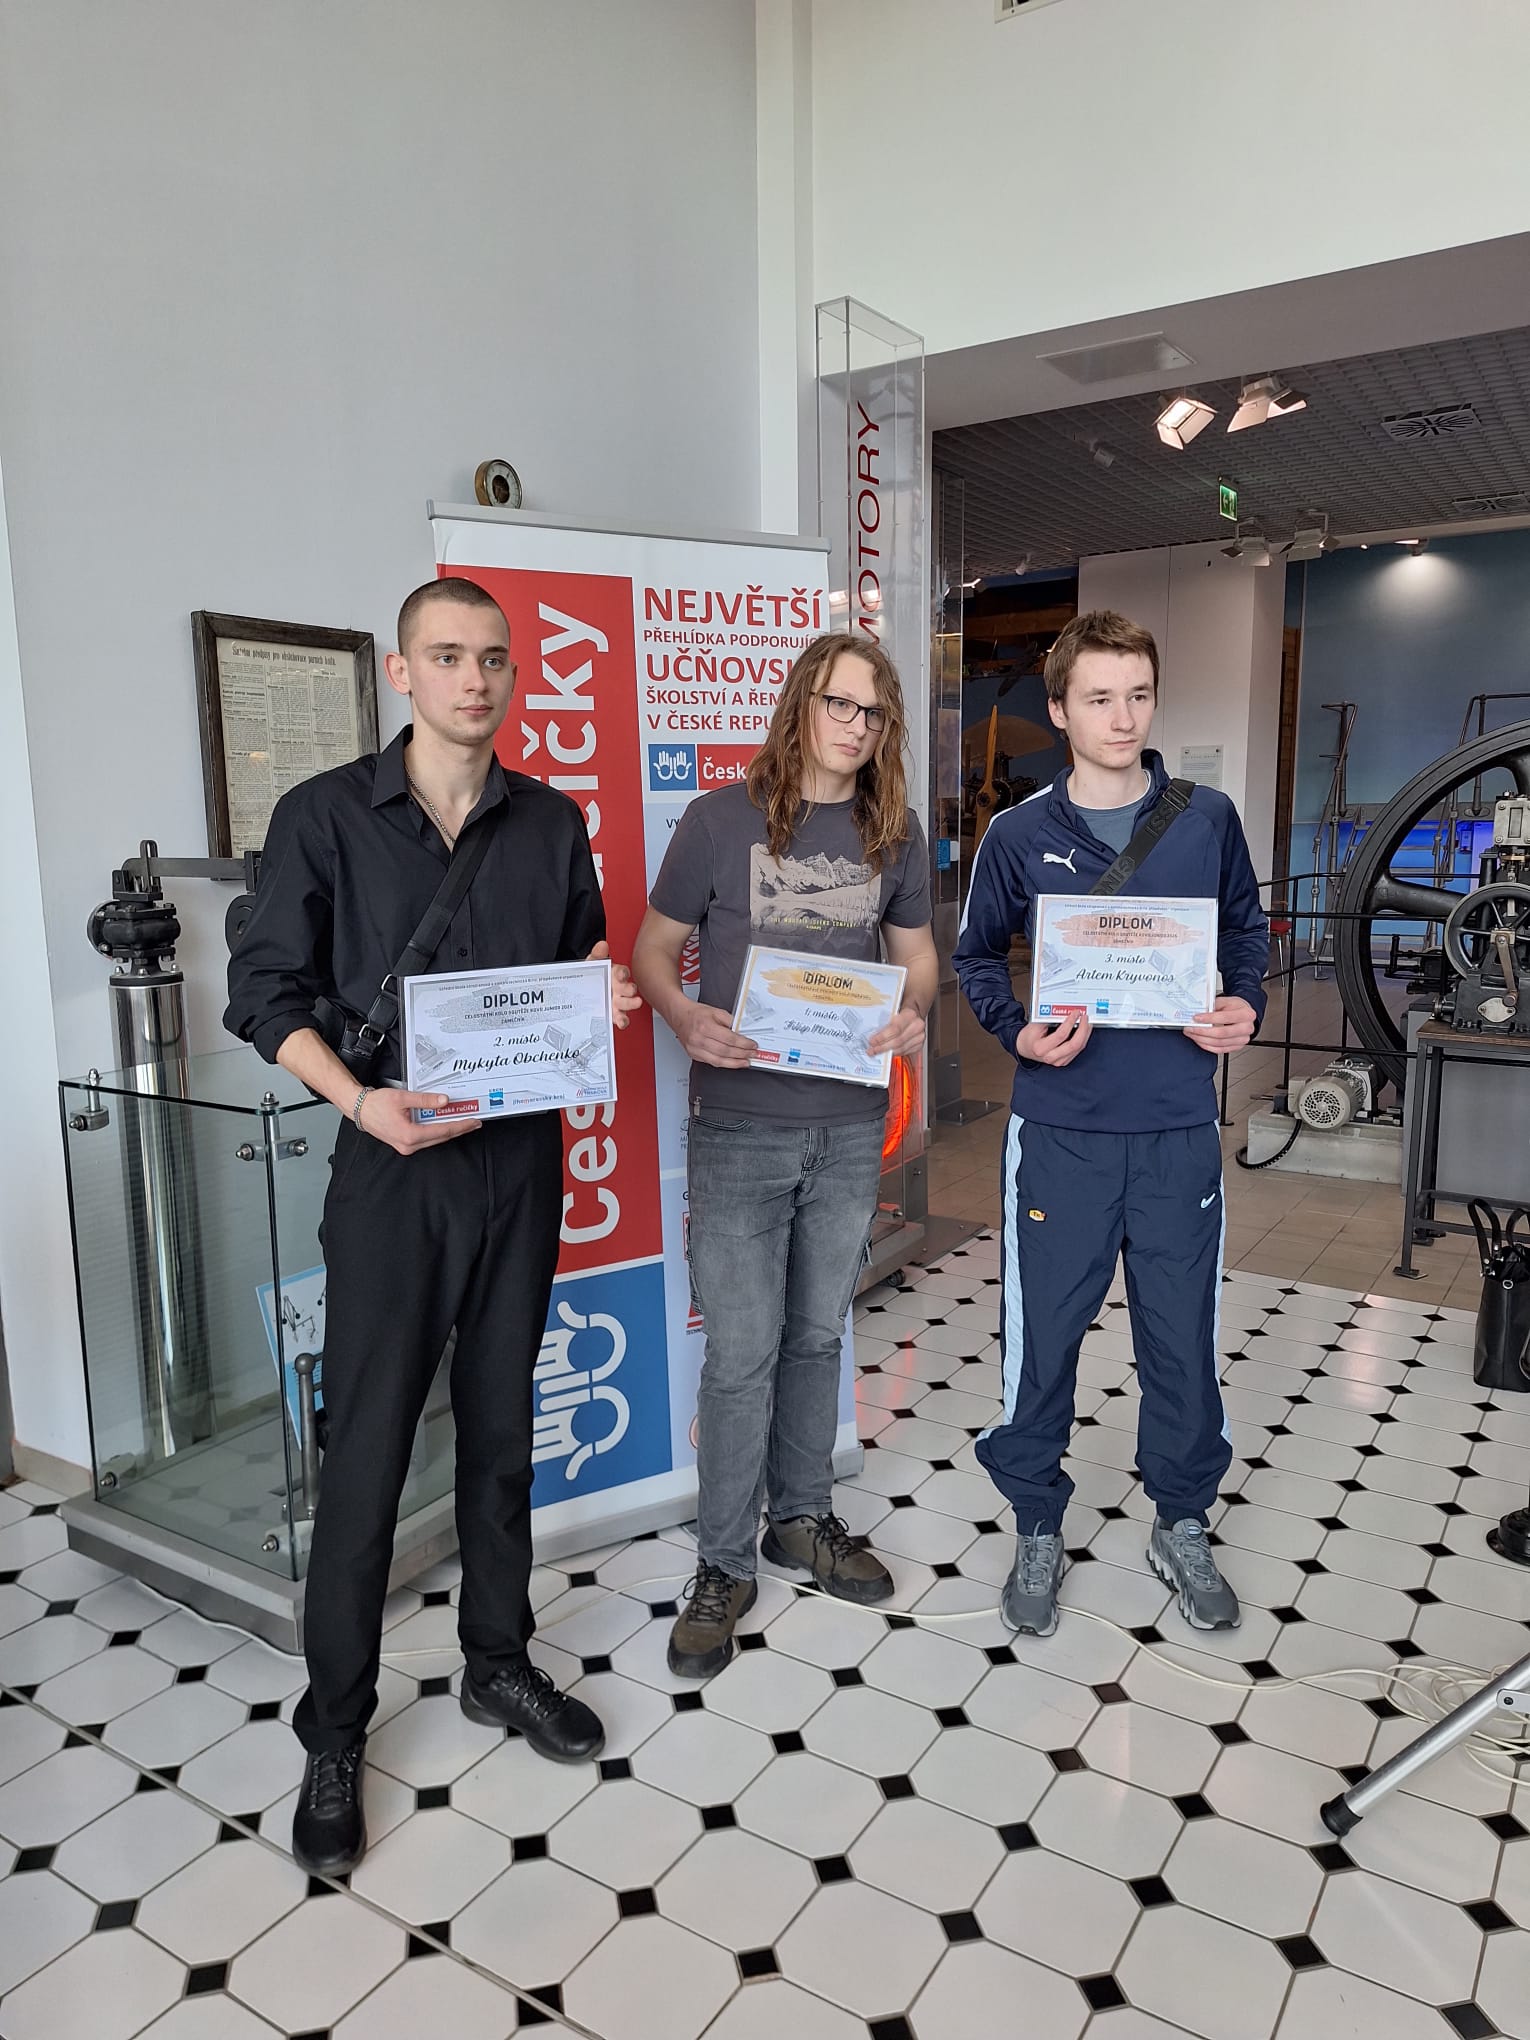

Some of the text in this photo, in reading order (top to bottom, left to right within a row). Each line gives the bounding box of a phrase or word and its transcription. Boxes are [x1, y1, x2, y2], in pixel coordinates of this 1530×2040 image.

[644, 584, 823, 629] NEJVĚTŠÍ
[644, 627, 817, 649] PŘEHLÍDKA PODPORUJÍC
[646, 648, 793, 684] UČŇOVS
[646, 686, 727, 705] ŠKOLSTVÍ
[732, 692, 743, 705] A
[647, 714, 661, 730] V
[667, 711, 723, 730] ČESKÉ
[703, 757, 747, 780] Česk
[1099, 917, 1153, 930] DIPLOM
[1104, 953, 1114, 964] 3.
[1076, 968, 1175, 985] Artem Kryvonos
[483, 990, 544, 1009] DIPLOM
[493, 1036, 505, 1047] 2.
[452, 1048, 580, 1074] Mykyta Obchenko
